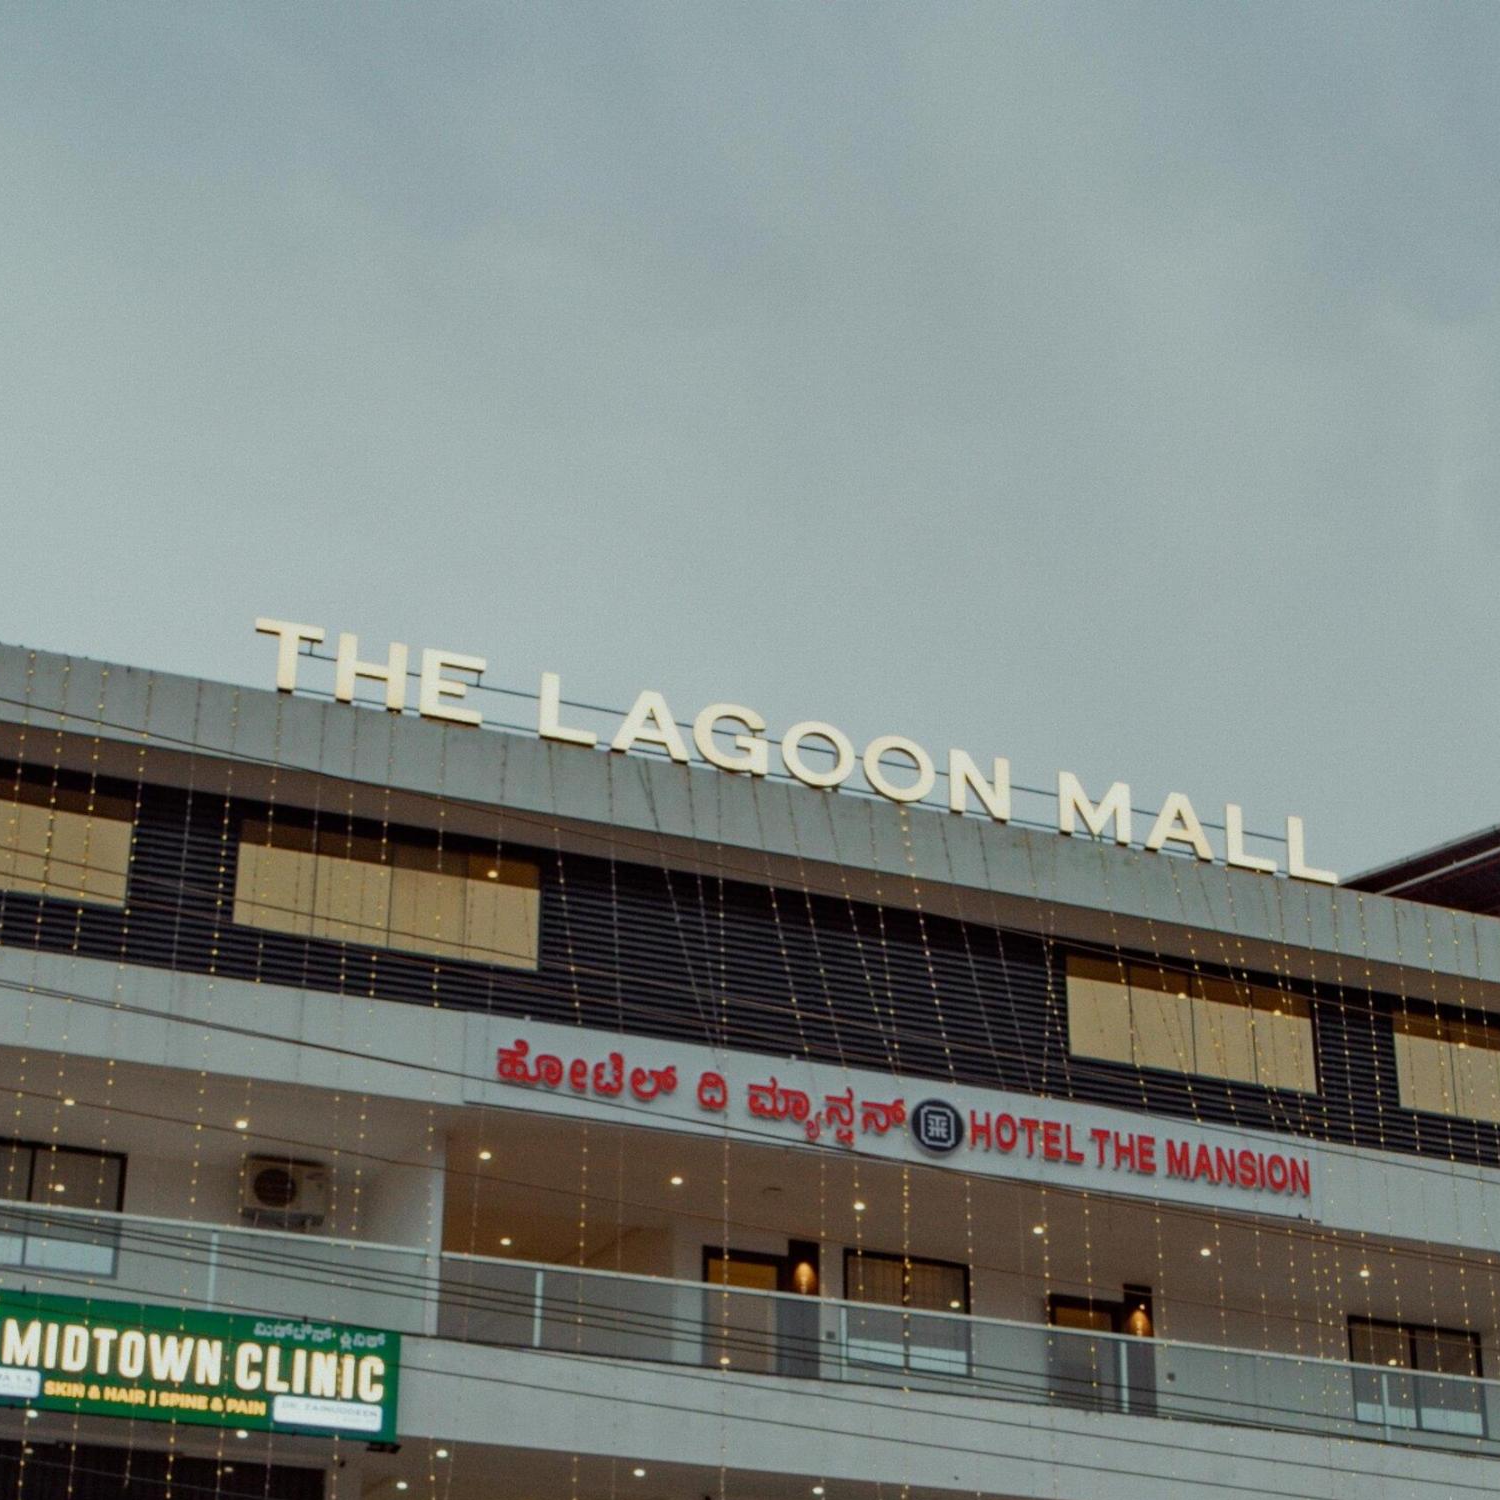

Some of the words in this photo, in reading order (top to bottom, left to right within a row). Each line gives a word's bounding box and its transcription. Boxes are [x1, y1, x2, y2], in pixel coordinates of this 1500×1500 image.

[254, 616, 486, 726] THE
[538, 671, 1012, 824] LAGOON
[1056, 770, 1340, 886] MALL
[496, 1038, 678, 1103] ಹೋಟೆಲ್
[697, 1070, 730, 1112] ದಿ
[968, 1111, 1086, 1167] HOTEL
[1092, 1129, 1157, 1175] THE
[1165, 1138, 1313, 1198] MANSION
[0, 1316, 224, 1387] MIDTOWN
[234, 1342, 386, 1403] CLINIC
[43, 1378, 86, 1399] SKIN
[87, 1384, 102, 1401] &
[102, 1385, 147, 1406] HAIR
[158, 1390, 209, 1412] SPINE
[209, 1395, 225, 1413] &
[226, 1397, 268, 1417] PAIN
